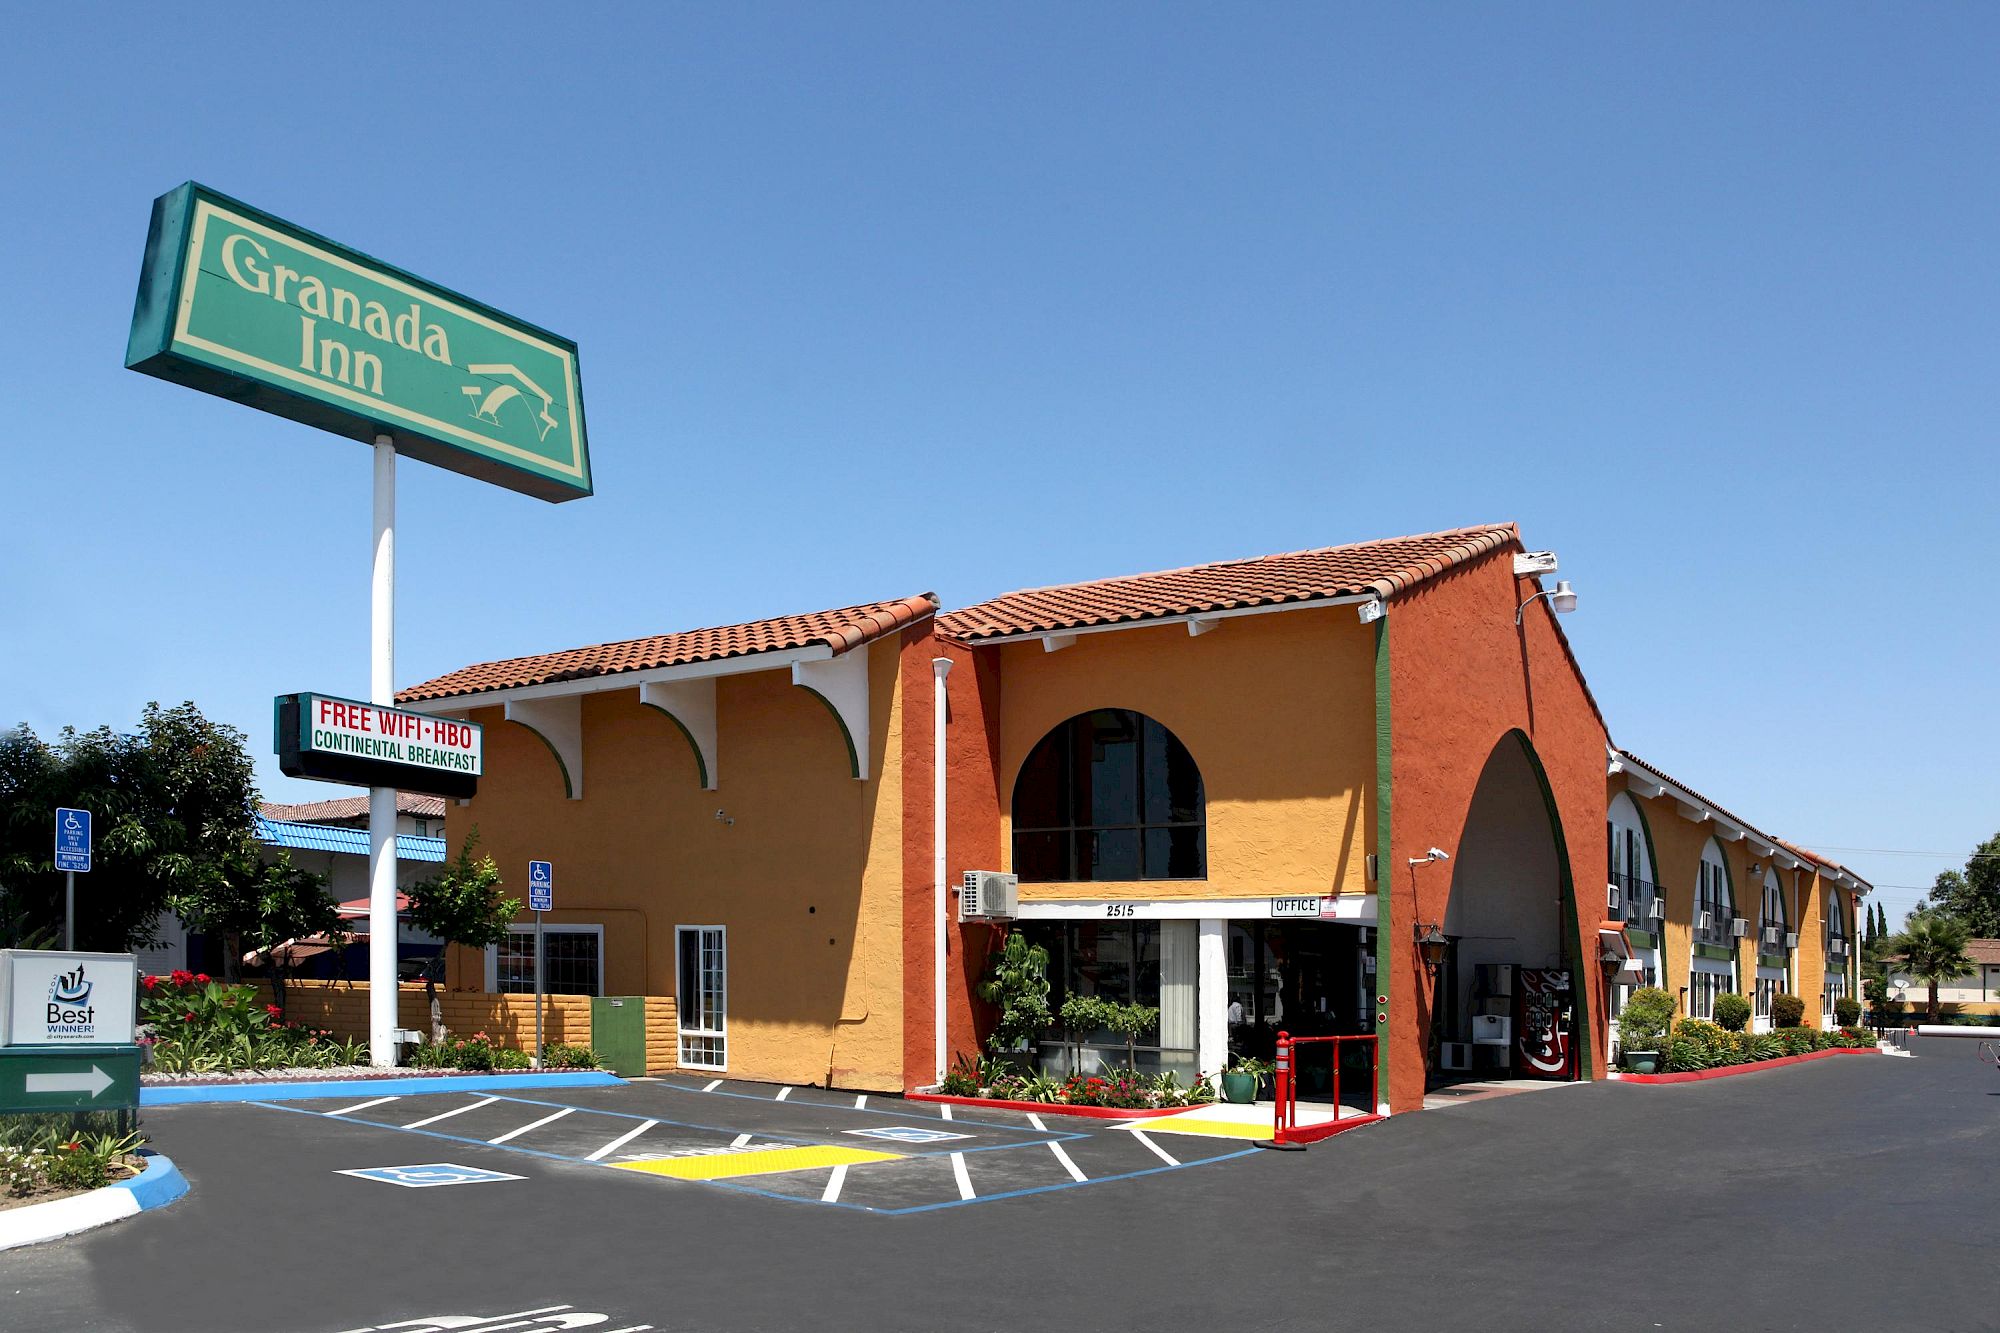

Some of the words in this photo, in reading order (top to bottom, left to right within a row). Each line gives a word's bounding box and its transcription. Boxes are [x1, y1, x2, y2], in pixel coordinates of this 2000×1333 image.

[221, 233, 453, 366] Granada
[299, 315, 384, 396] Inn
[320, 700, 371, 732] FREE
[378, 710, 422, 741] WIFI
[434, 721, 472, 749] HBO
[314, 729, 404, 760] CONTINENTAL
[408, 745, 476, 771] BREAKFAST
[61, 854, 85, 862] MINIMUM
[530, 880, 550, 889] PARKING
[534, 888, 547, 896] ONLY
[1107, 904, 1134, 917] 2515
[1276, 899, 1316, 911] OFFICE
[47, 1002, 95, 1024] Best
[47, 1025, 95, 1033] WINNER!
